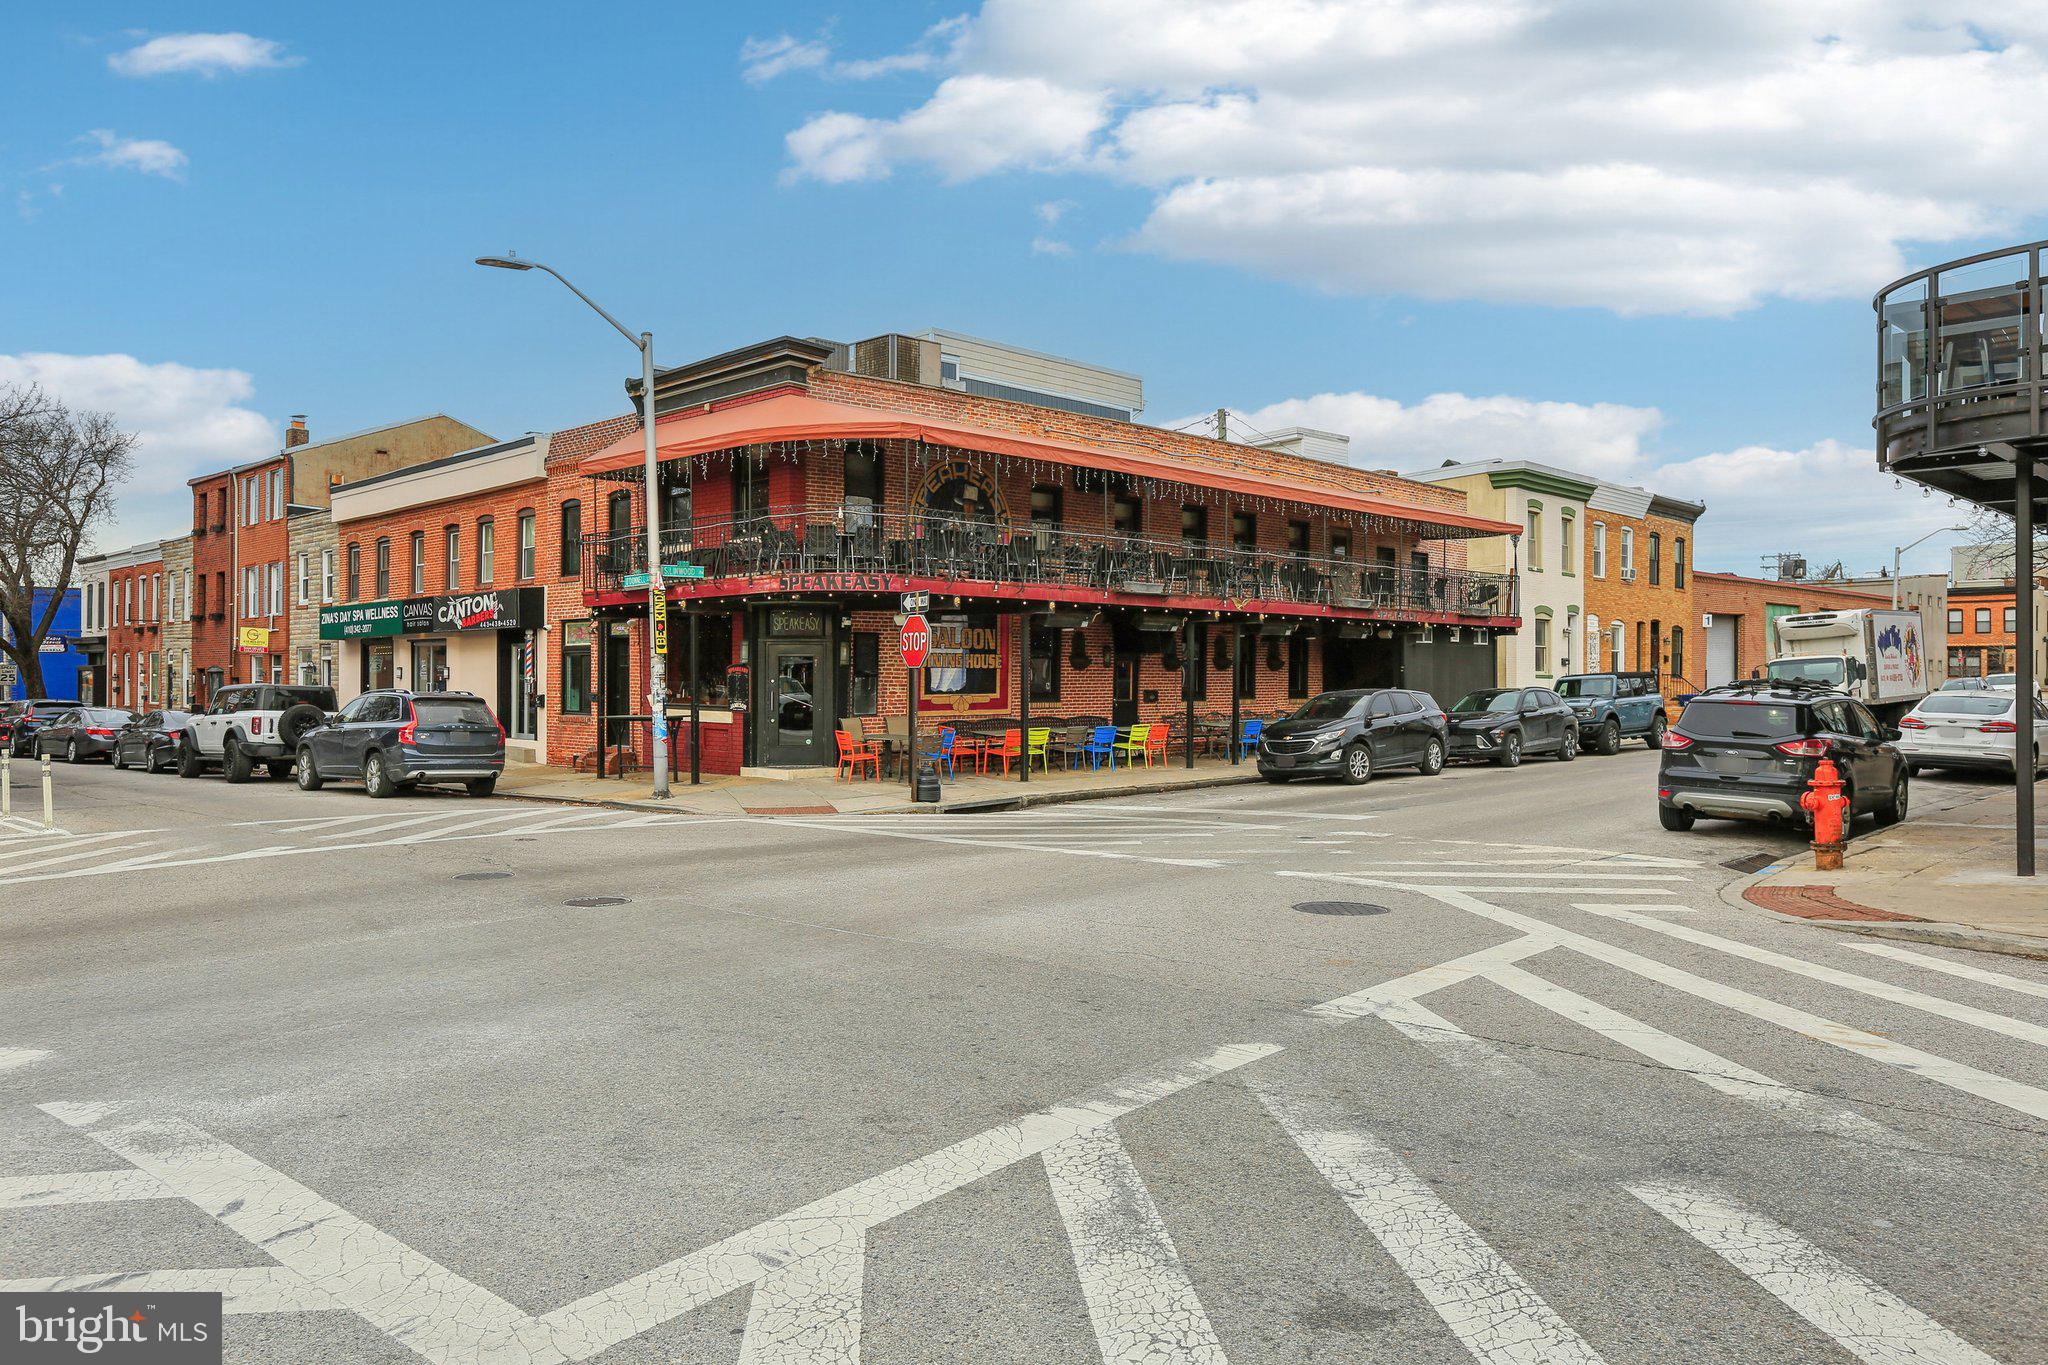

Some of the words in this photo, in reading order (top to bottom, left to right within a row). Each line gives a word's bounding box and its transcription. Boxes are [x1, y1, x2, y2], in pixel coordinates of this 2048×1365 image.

[779, 574, 893, 591] SPEAKEASY
[339, 610, 352, 623] DAY
[352, 609, 364, 622] SPA
[364, 605, 399, 620] WELLNESS
[403, 603, 433, 618] CANVAS
[438, 593, 494, 622] CANTON
[461, 609, 494, 628] BARBERS
[773, 616, 820, 631] SPEAKEASY
[1705, 616, 1710, 625] 1
[902, 632, 927, 652] STOP
[965, 653, 1002, 669] HOUSE
[0, 673, 16, 682] 25
